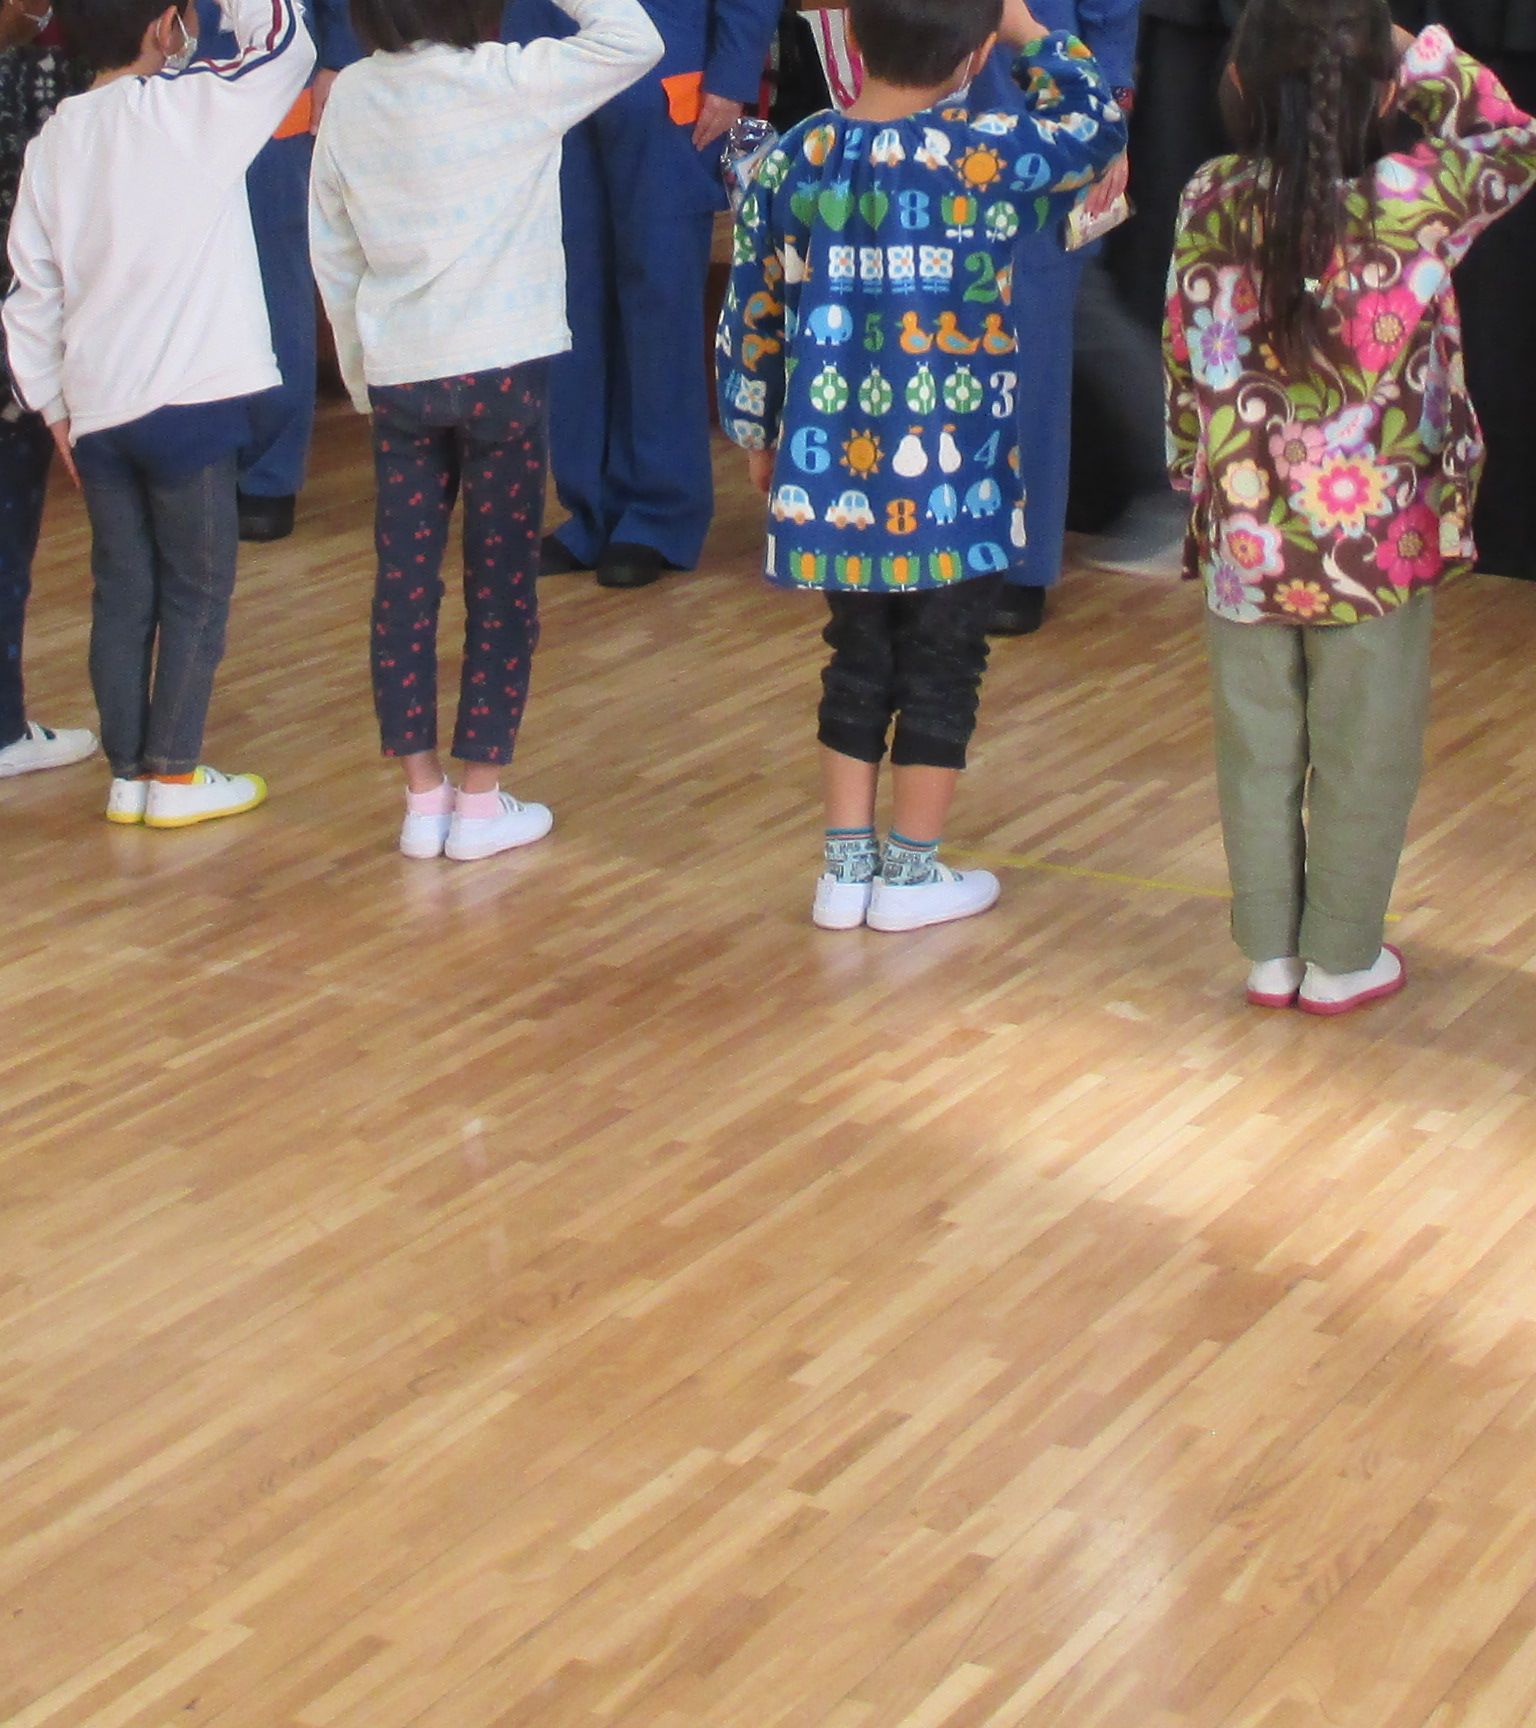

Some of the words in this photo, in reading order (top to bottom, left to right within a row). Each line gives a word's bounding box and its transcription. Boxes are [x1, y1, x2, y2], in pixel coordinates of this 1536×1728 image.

[1010, 153, 1051, 192] 9
[898, 190, 930, 229] 8
[963, 252, 999, 303] 2
[864, 312, 884, 352] 5
[989, 371, 1017, 418] 3
[790, 427, 831, 474] 6
[973, 430, 1000, 469] 4
[885, 498, 918, 535] 8
